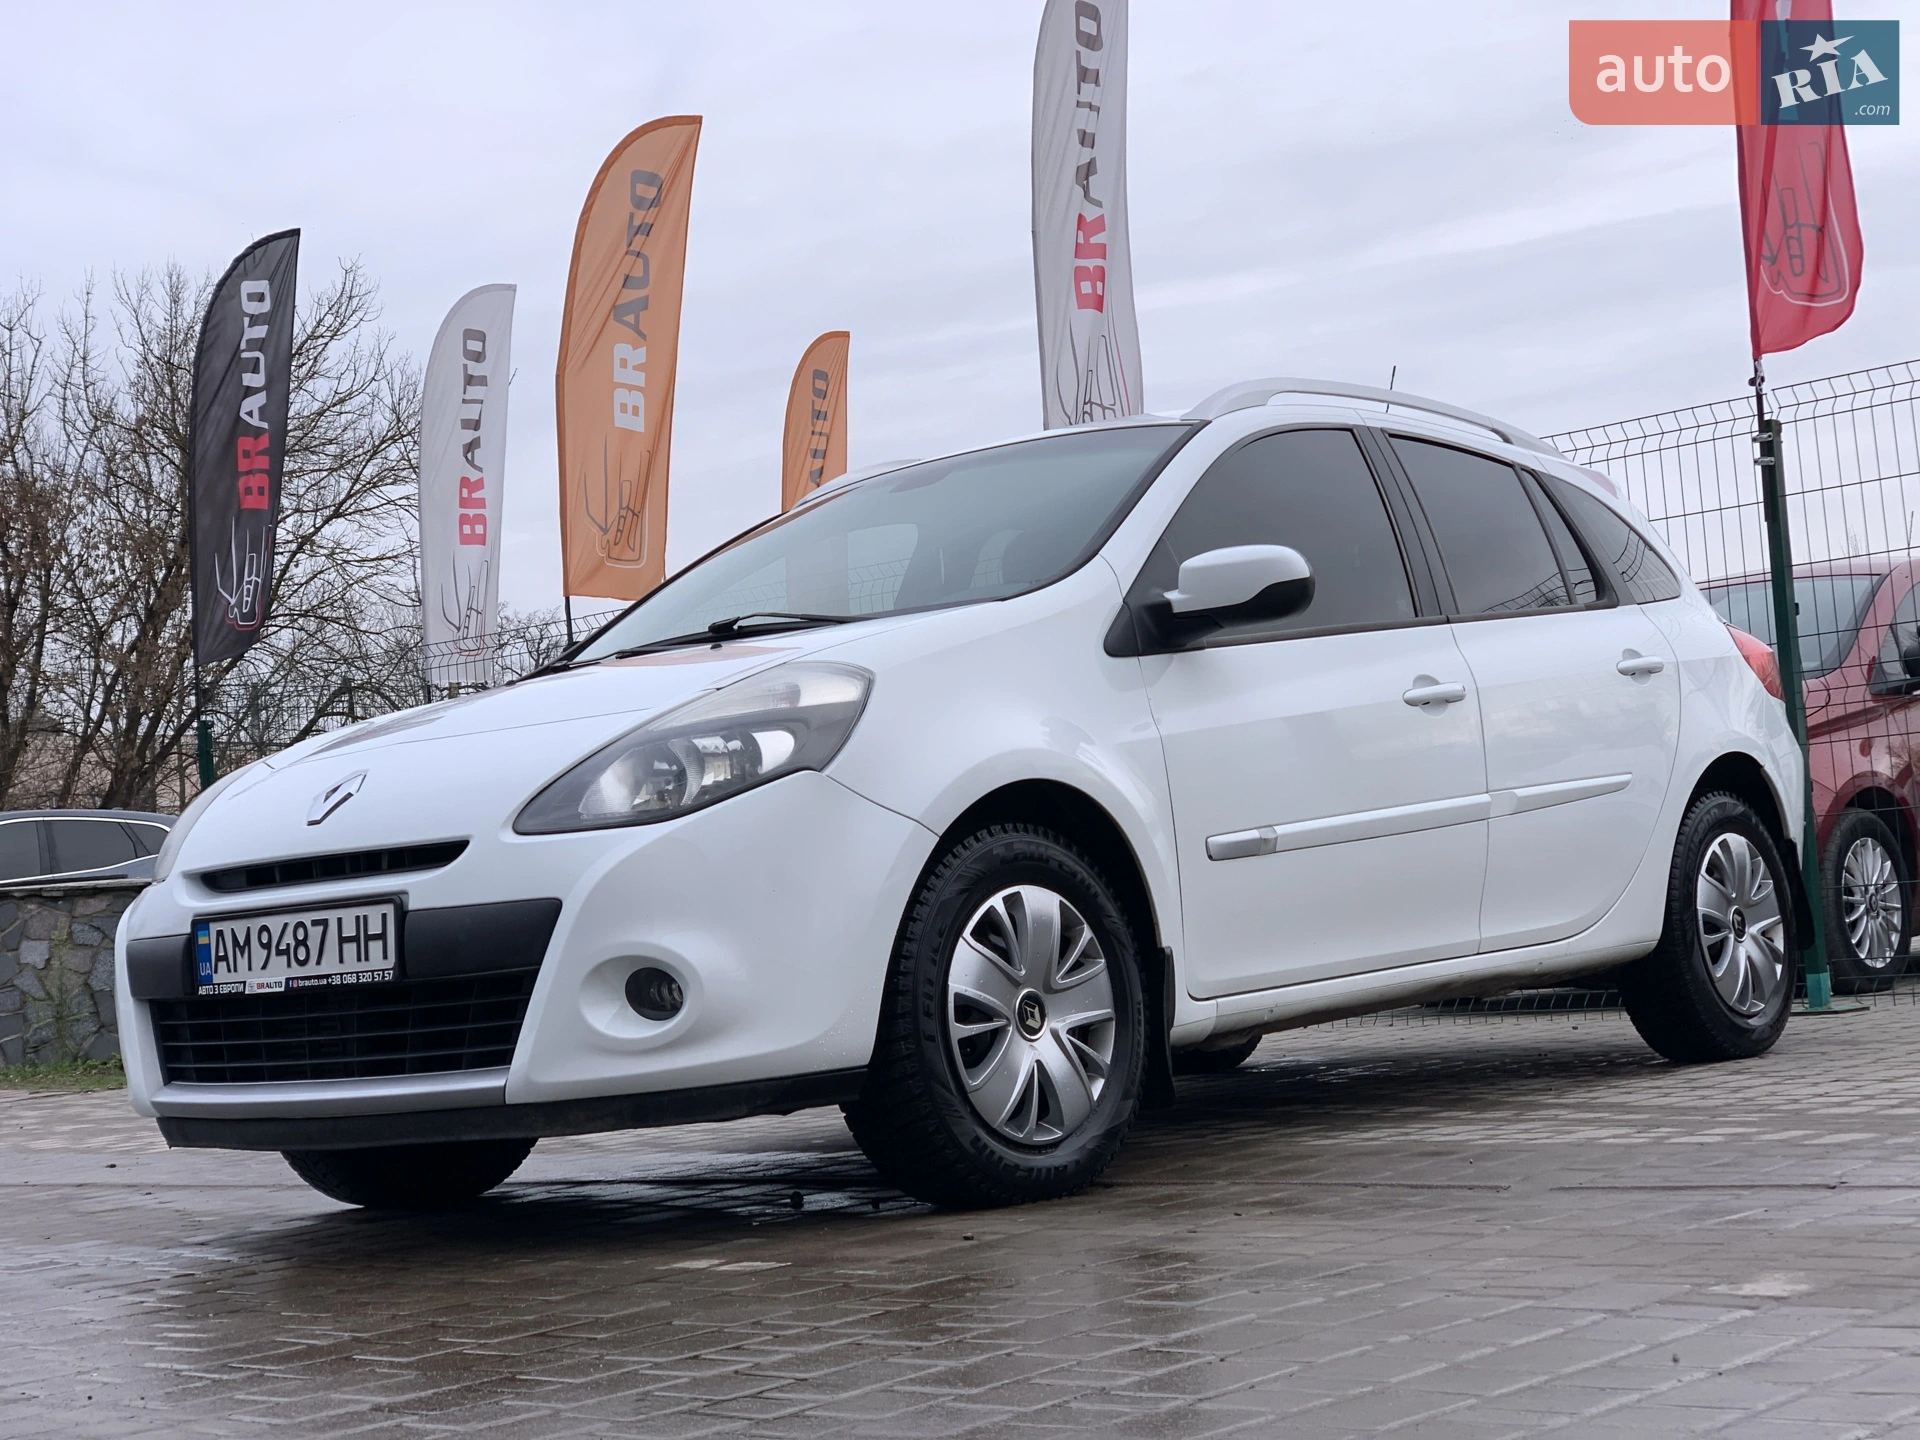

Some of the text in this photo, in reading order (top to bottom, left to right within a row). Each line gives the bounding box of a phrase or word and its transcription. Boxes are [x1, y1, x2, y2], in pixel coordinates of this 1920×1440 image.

[1073, 0, 1107, 314] BRAUTO
[236, 279, 272, 511] BRAUTO
[612, 168, 665, 433] BRAUTO
[458, 327, 489, 547] BRAUTO
[200, 962, 212, 976] UA
[256, 981, 283, 990] BRAUTO
[298, 970, 394, 987] brauto.ua +38 068 320 57 57
